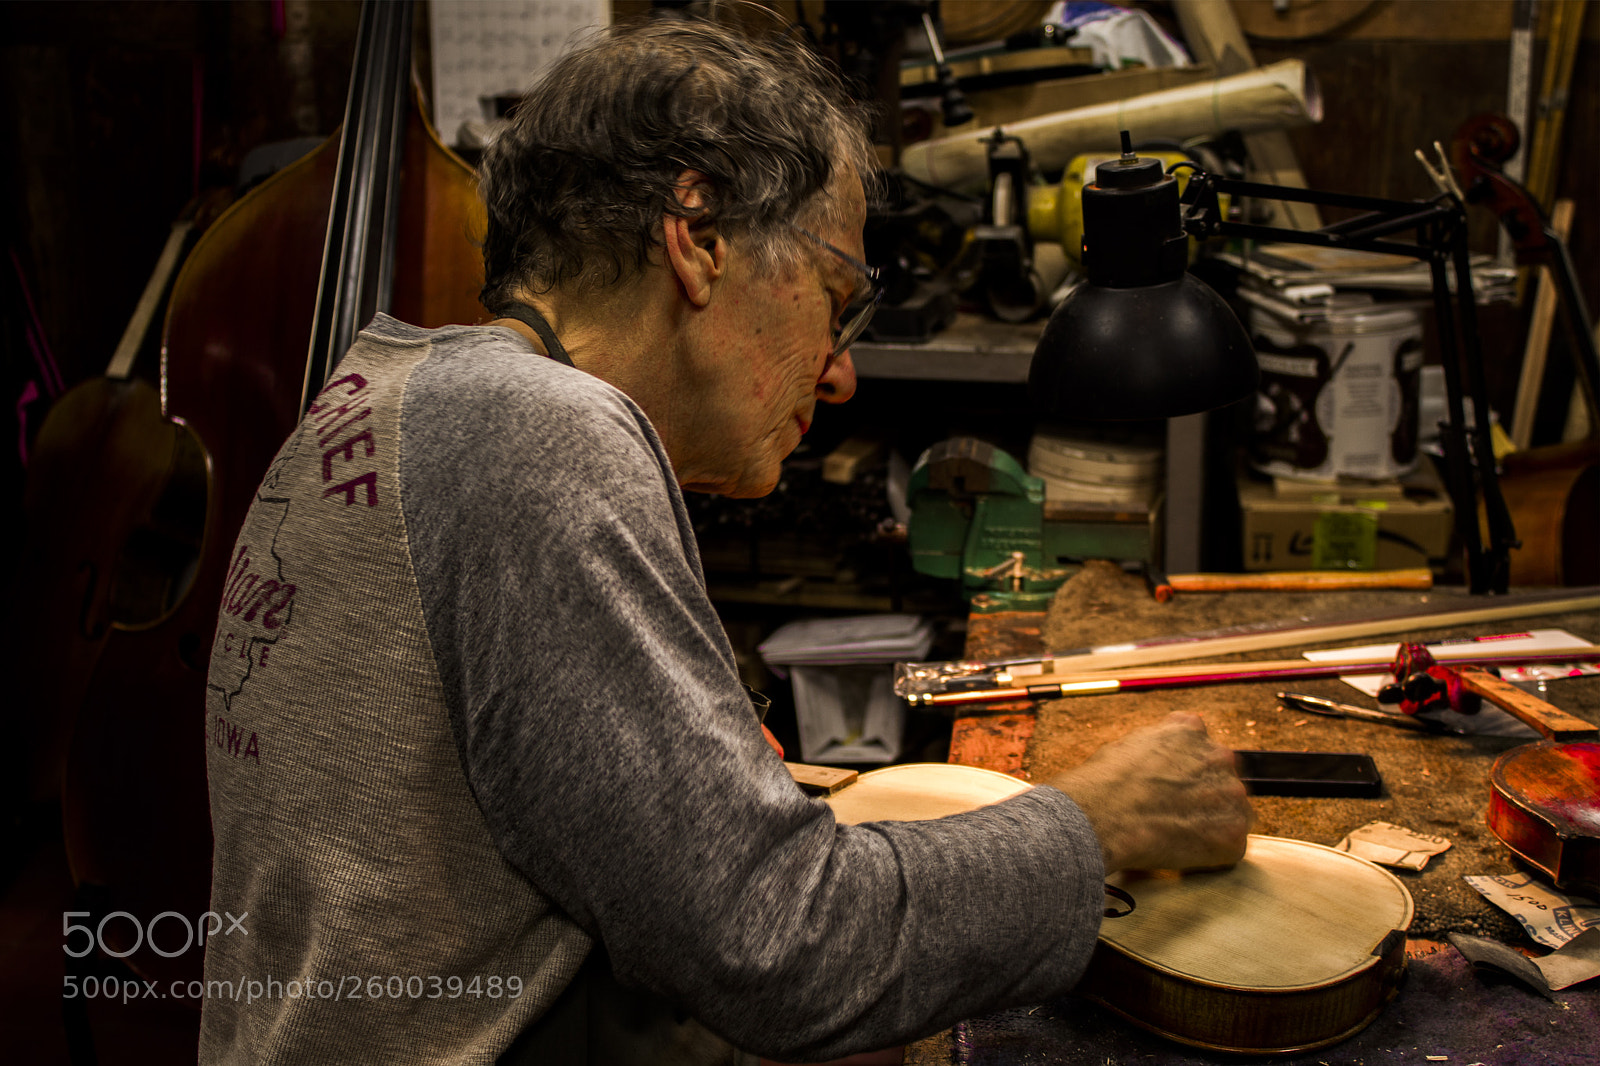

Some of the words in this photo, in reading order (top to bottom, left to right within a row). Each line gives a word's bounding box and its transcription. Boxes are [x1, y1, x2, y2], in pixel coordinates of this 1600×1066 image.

[309, 373, 378, 506] CHIEF
[218, 630, 269, 667] CLE
[214, 715, 260, 765] IOWA
[1506, 893, 1547, 911] 1500
